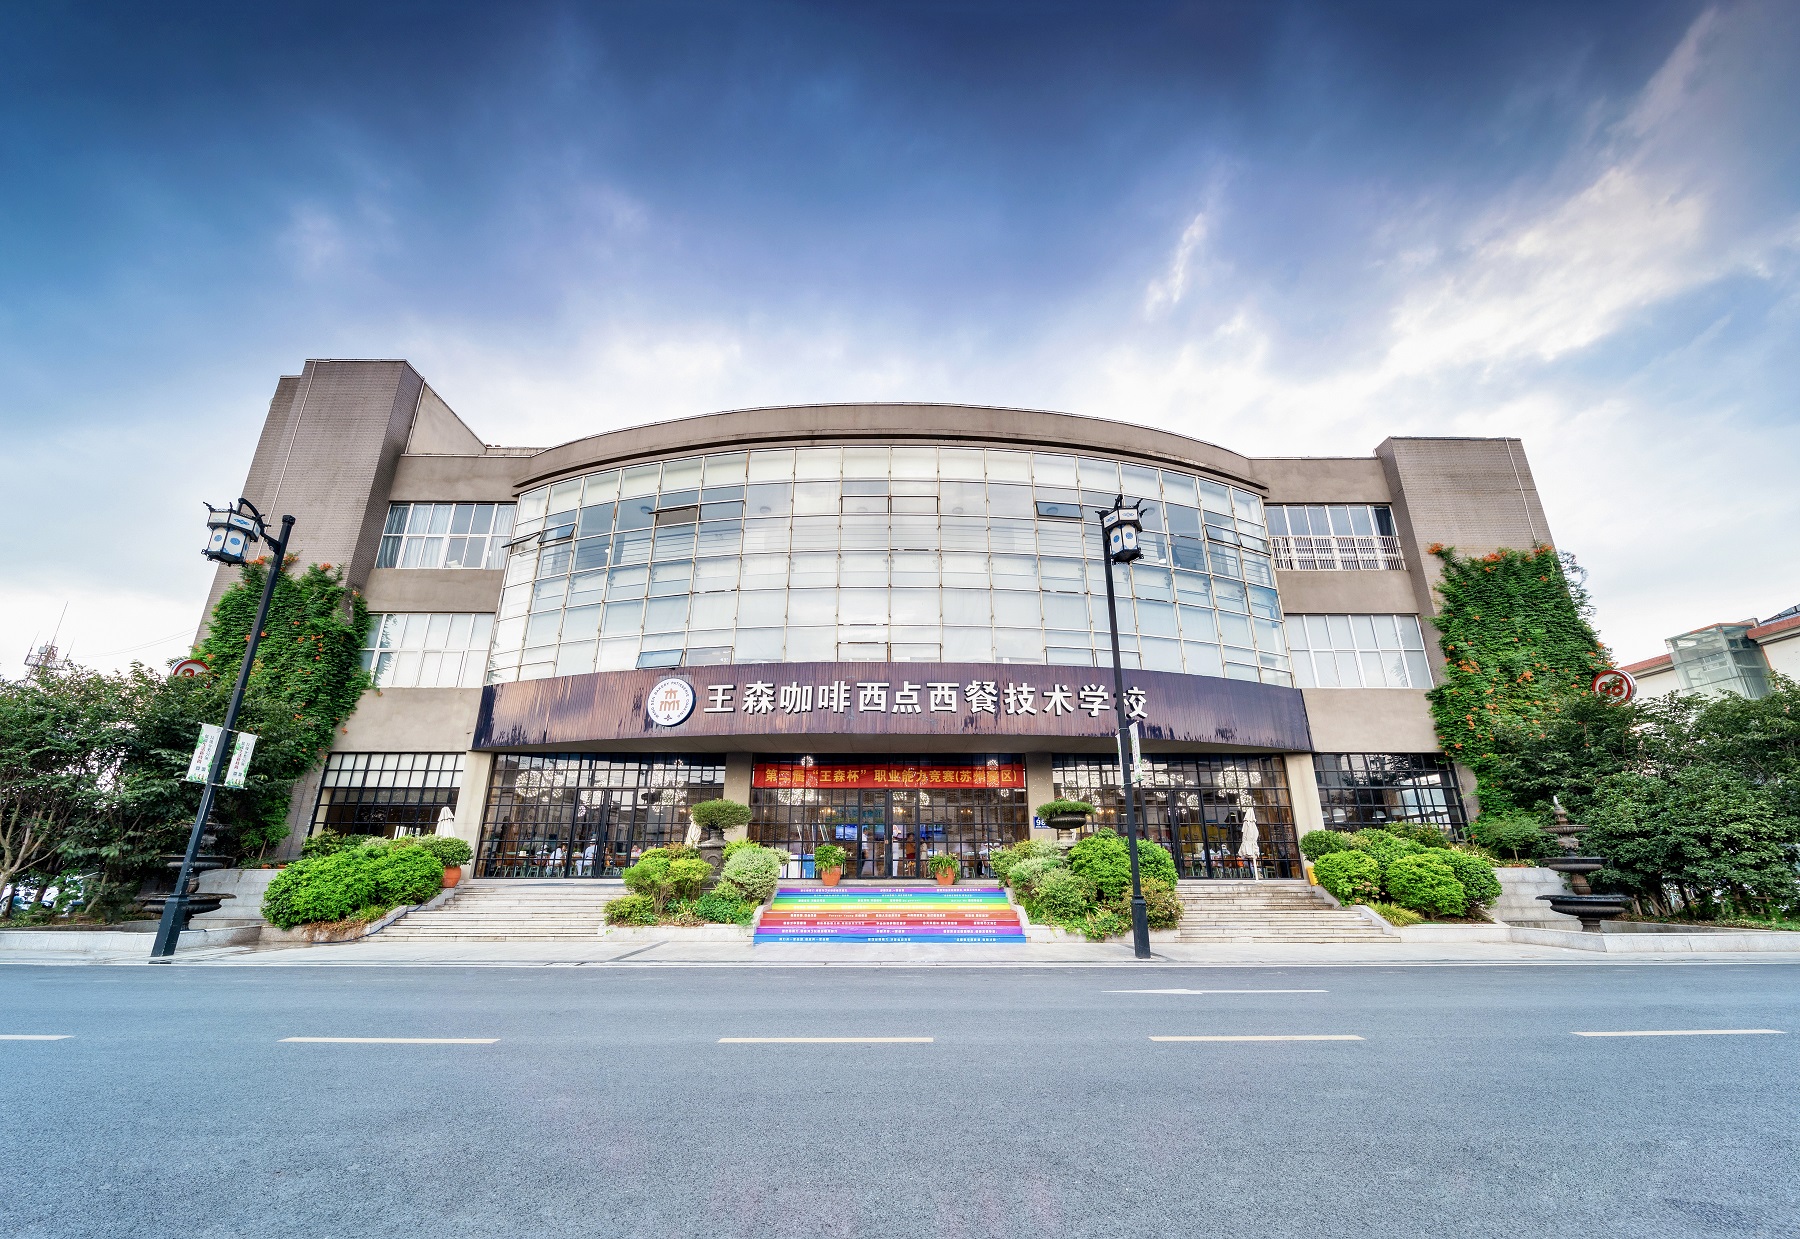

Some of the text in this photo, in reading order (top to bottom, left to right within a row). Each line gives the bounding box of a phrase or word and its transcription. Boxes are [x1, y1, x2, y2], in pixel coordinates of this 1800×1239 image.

[704, 680, 1148, 718] 王森咖啡西点西餐技术学校
